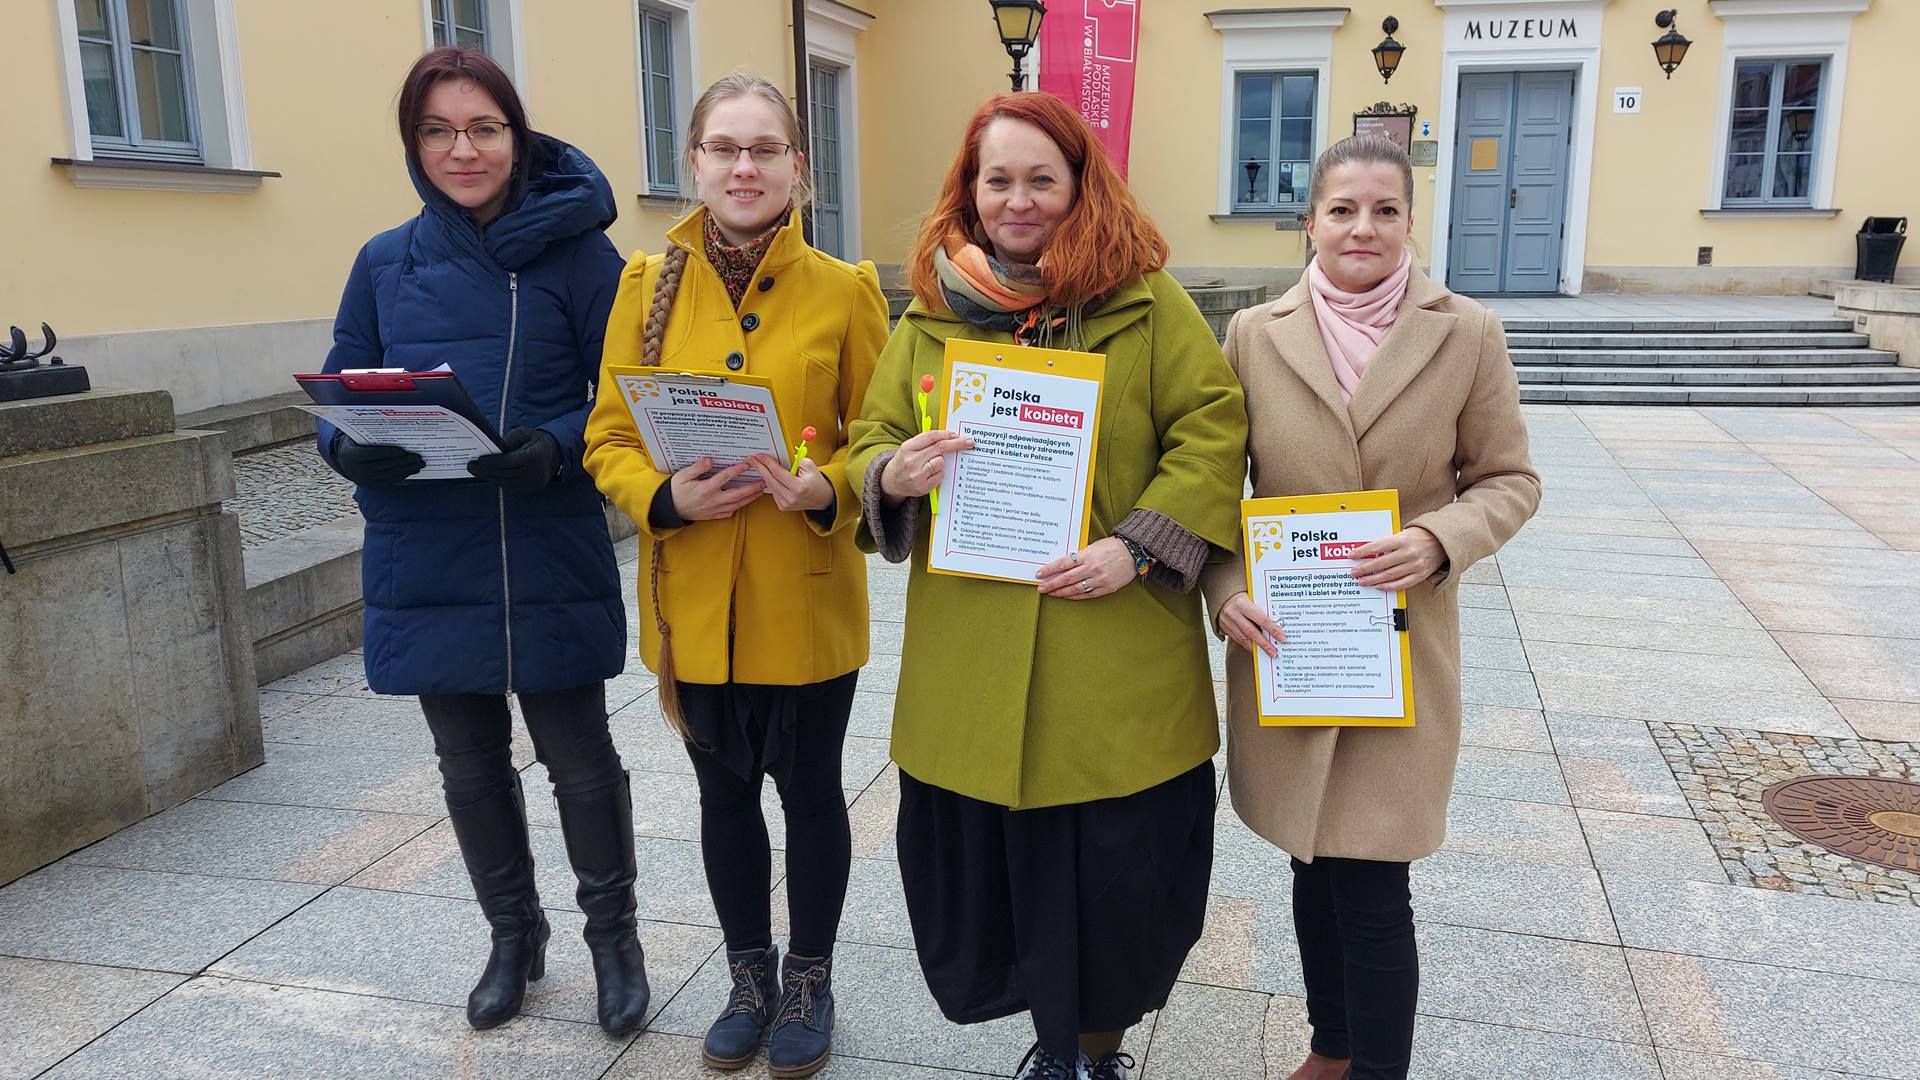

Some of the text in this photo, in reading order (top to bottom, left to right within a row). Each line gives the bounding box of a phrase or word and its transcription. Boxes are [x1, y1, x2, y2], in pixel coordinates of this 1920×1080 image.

[1464, 18, 1577, 39] MUZEUM
[1090, 63, 1101, 128] PODLASKIE
[1101, 64, 1111, 118] MUZEUM
[1619, 97, 1635, 109] 10
[668, 387, 718, 398] Polska
[993, 387, 1041, 403] Polska
[671, 396, 760, 412] jest kobietą
[991, 402, 1079, 428] jest kobietą
[972, 429, 1008, 439] propozycji
[1008, 434, 1071, 447] odpowiadających
[1001, 449, 1022, 458] kobiet
[1030, 453, 1053, 461] Polsce
[1006, 442, 1037, 452] potrzeby
[1037, 447, 1074, 456] zdrowotne
[1291, 529, 1338, 542] Polska
[1292, 546, 1319, 562] jest
[1277, 573, 1313, 582] propozycji
[1312, 581, 1343, 589] potrzeby
[1270, 590, 1304, 598] dziewcząt
